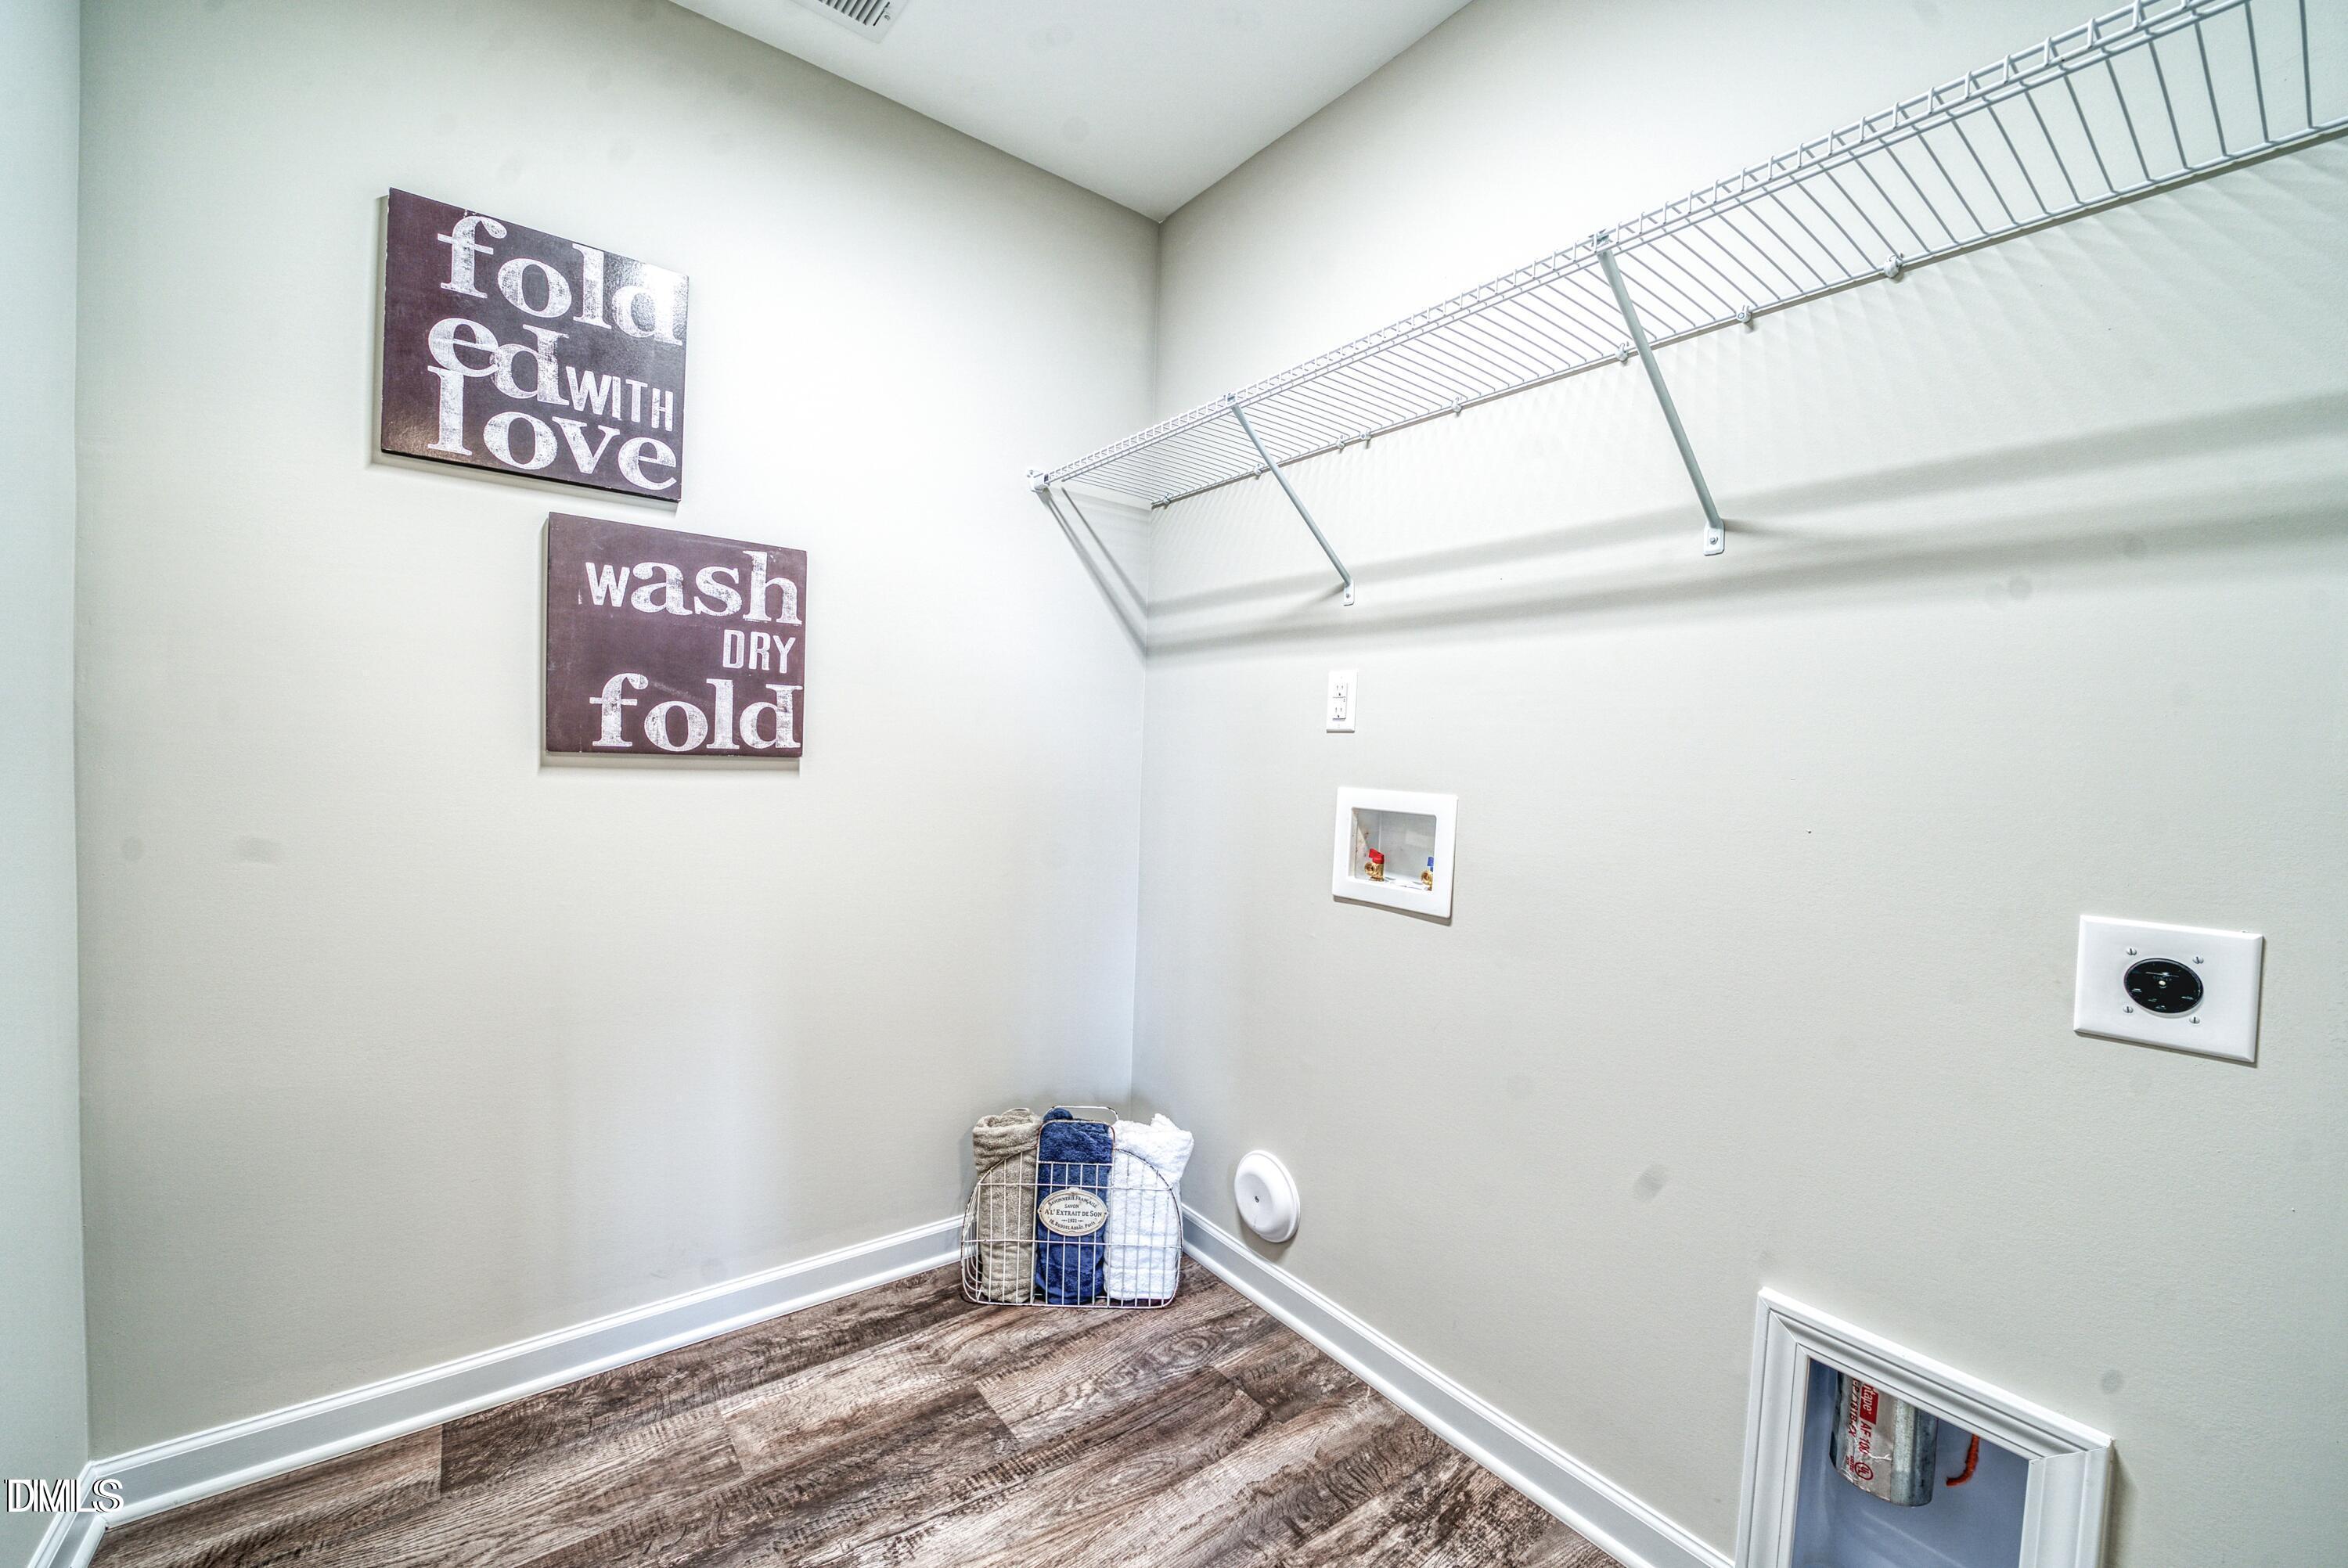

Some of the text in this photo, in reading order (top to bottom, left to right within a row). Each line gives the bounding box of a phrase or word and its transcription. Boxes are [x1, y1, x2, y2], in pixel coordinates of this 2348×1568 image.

[437, 215, 682, 346] fold
[428, 318, 674, 432] ed WITH
[427, 365, 678, 491] love
[585, 550, 803, 625] wash
[722, 629, 797, 674] DRY
[589, 672, 804, 752] fold
[1860, 1421, 1872, 1437] AF
